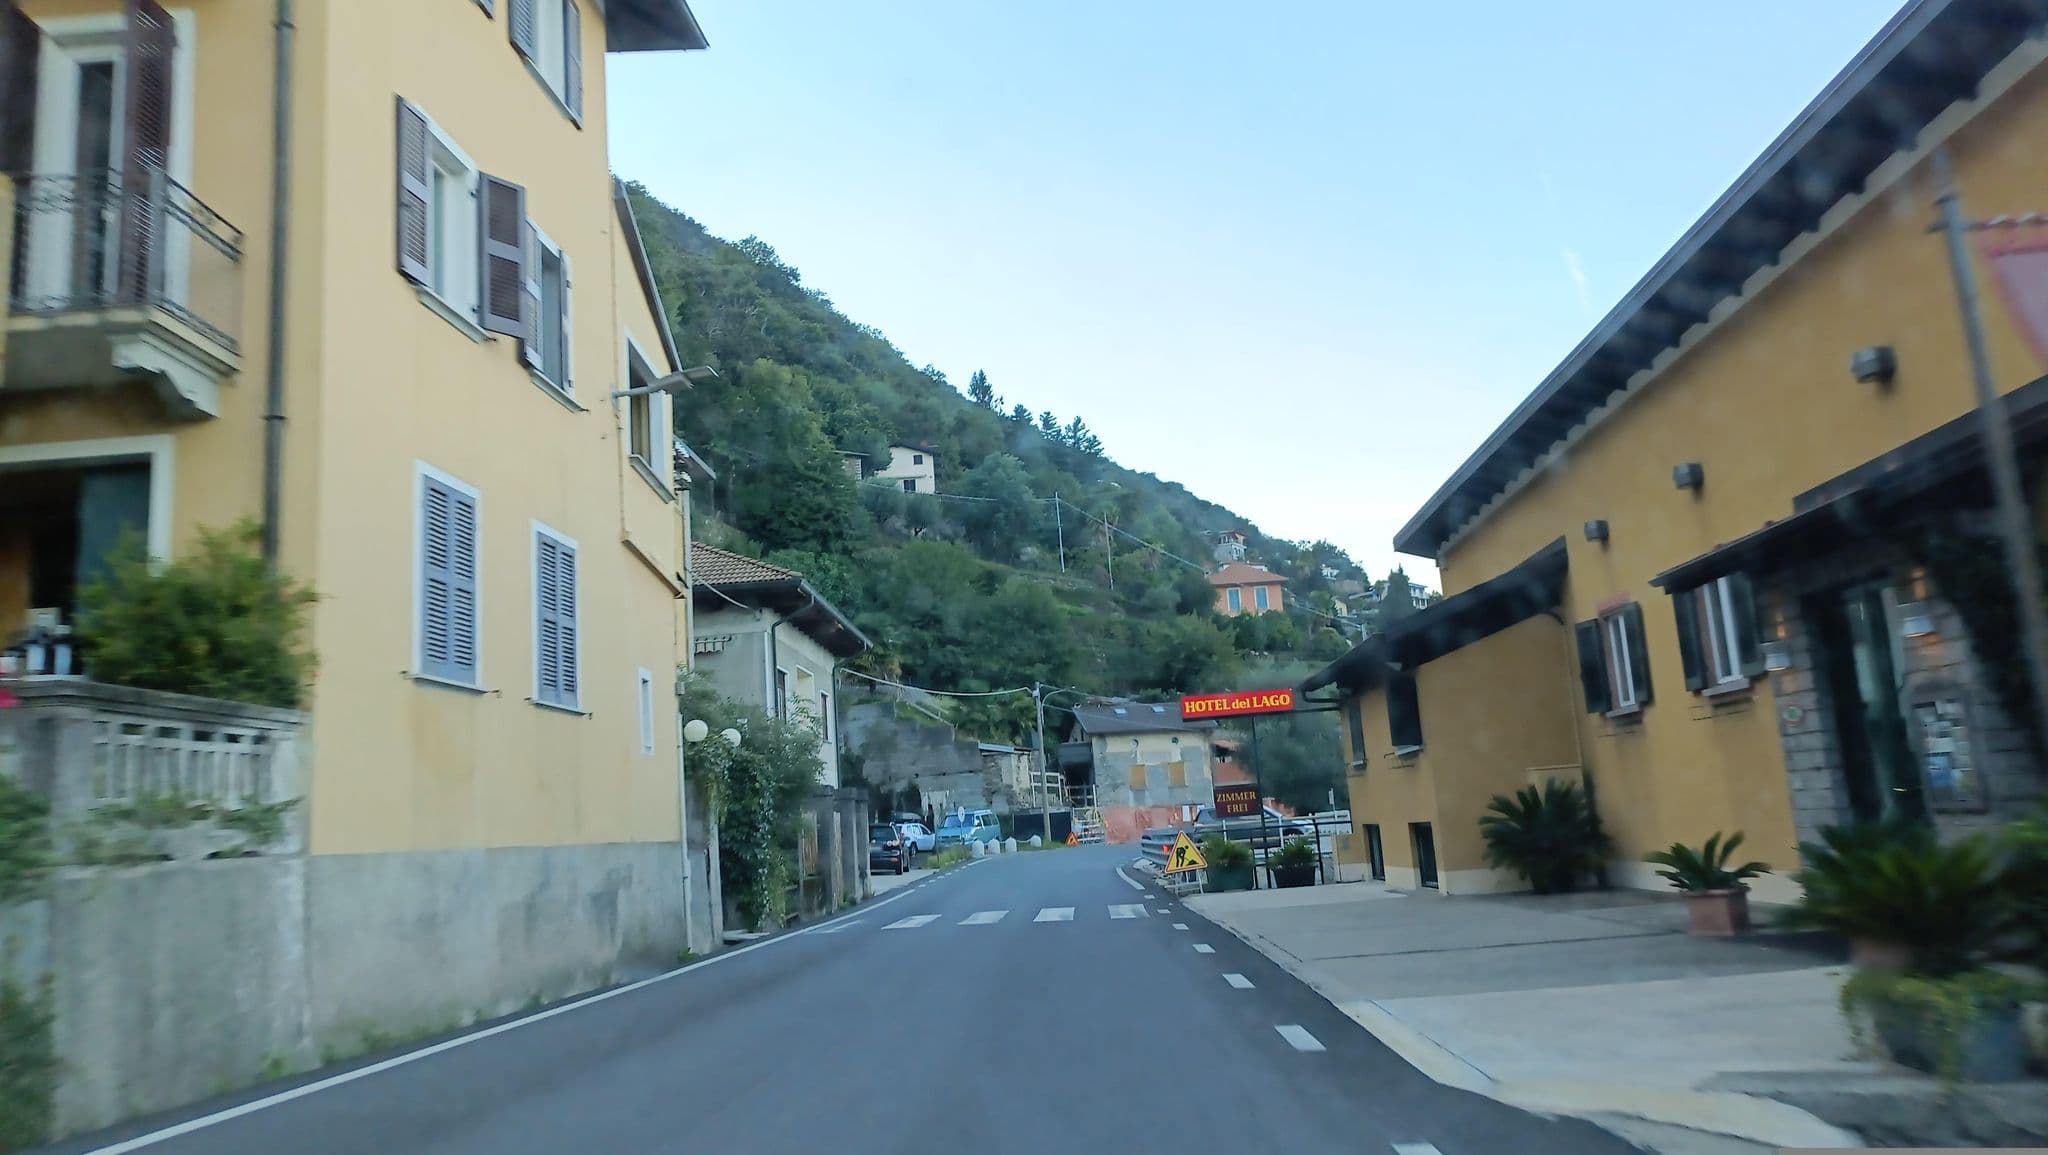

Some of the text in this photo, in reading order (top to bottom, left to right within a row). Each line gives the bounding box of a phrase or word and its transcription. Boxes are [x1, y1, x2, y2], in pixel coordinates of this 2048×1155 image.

[1184, 694, 1290, 713] HOTEL del LAGO
[1216, 791, 1256, 802] ZIMMER
[1226, 803, 1248, 813] FREI
